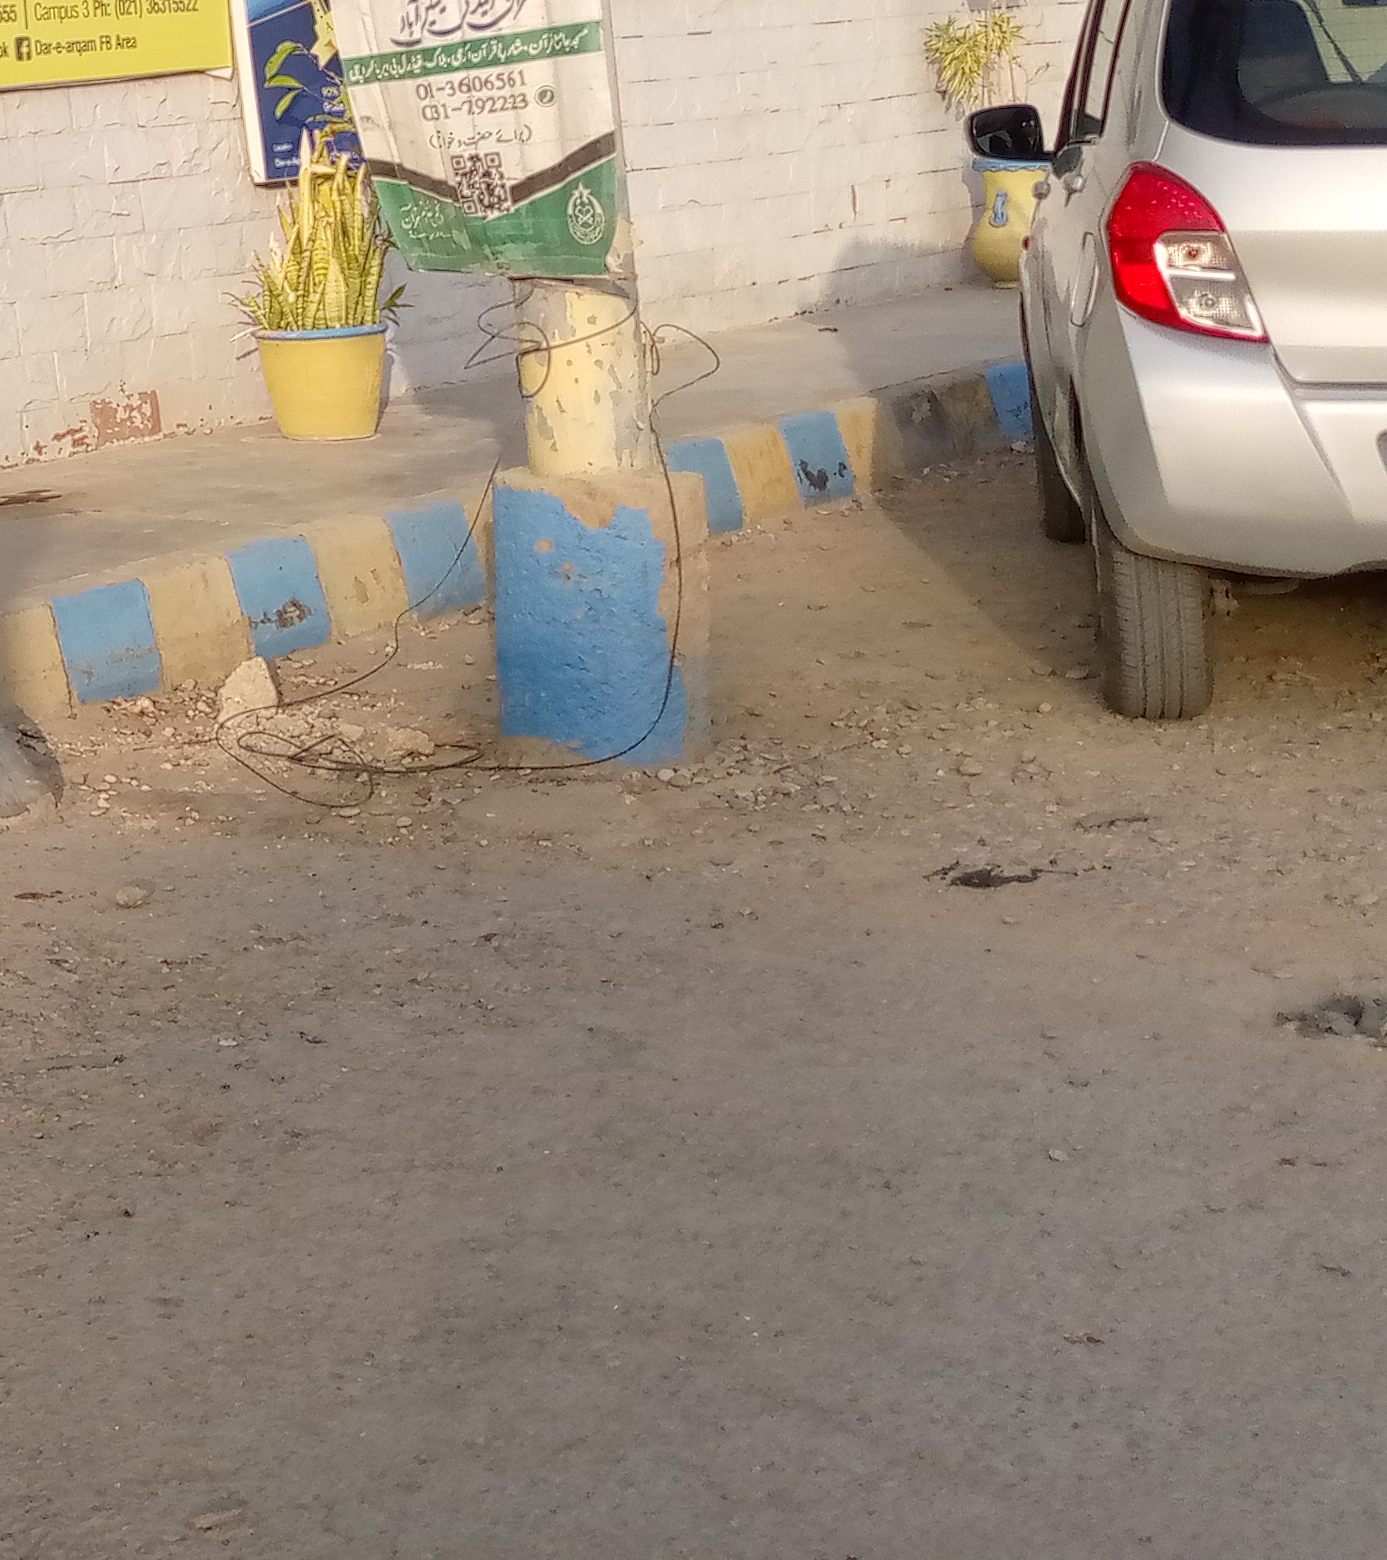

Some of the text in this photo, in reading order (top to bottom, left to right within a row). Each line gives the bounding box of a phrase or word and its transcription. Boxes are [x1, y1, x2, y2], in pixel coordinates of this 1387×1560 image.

[34, 2, 79, 26] Campus
[81, 0, 90, 19] 3
[35, 37, 97, 57] Dar-e-arqam
[99, 36, 112, 52] FB
[115, 34, 137, 51] Area
